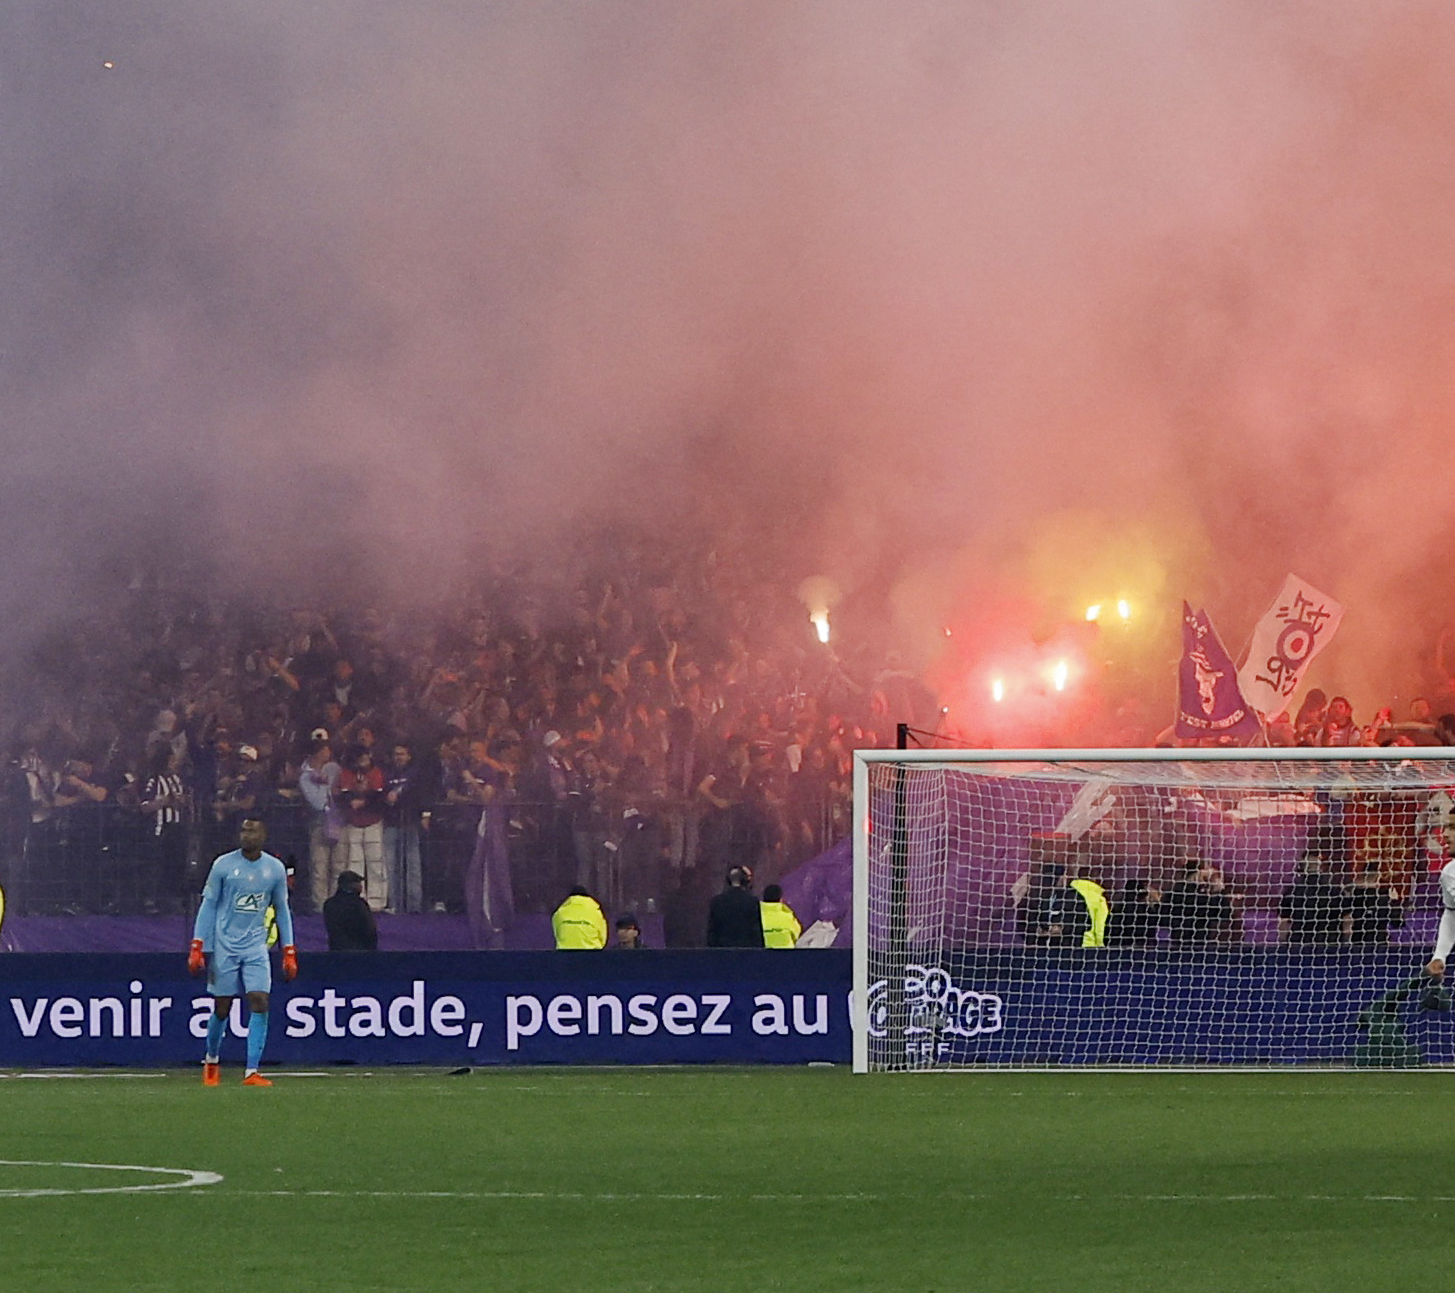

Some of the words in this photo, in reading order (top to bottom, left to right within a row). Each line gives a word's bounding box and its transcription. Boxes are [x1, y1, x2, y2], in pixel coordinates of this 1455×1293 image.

[11, 981, 173, 1038] venir
[286, 981, 483, 1047] stade,
[507, 994, 731, 1049] pensez
[753, 994, 828, 1036] au
